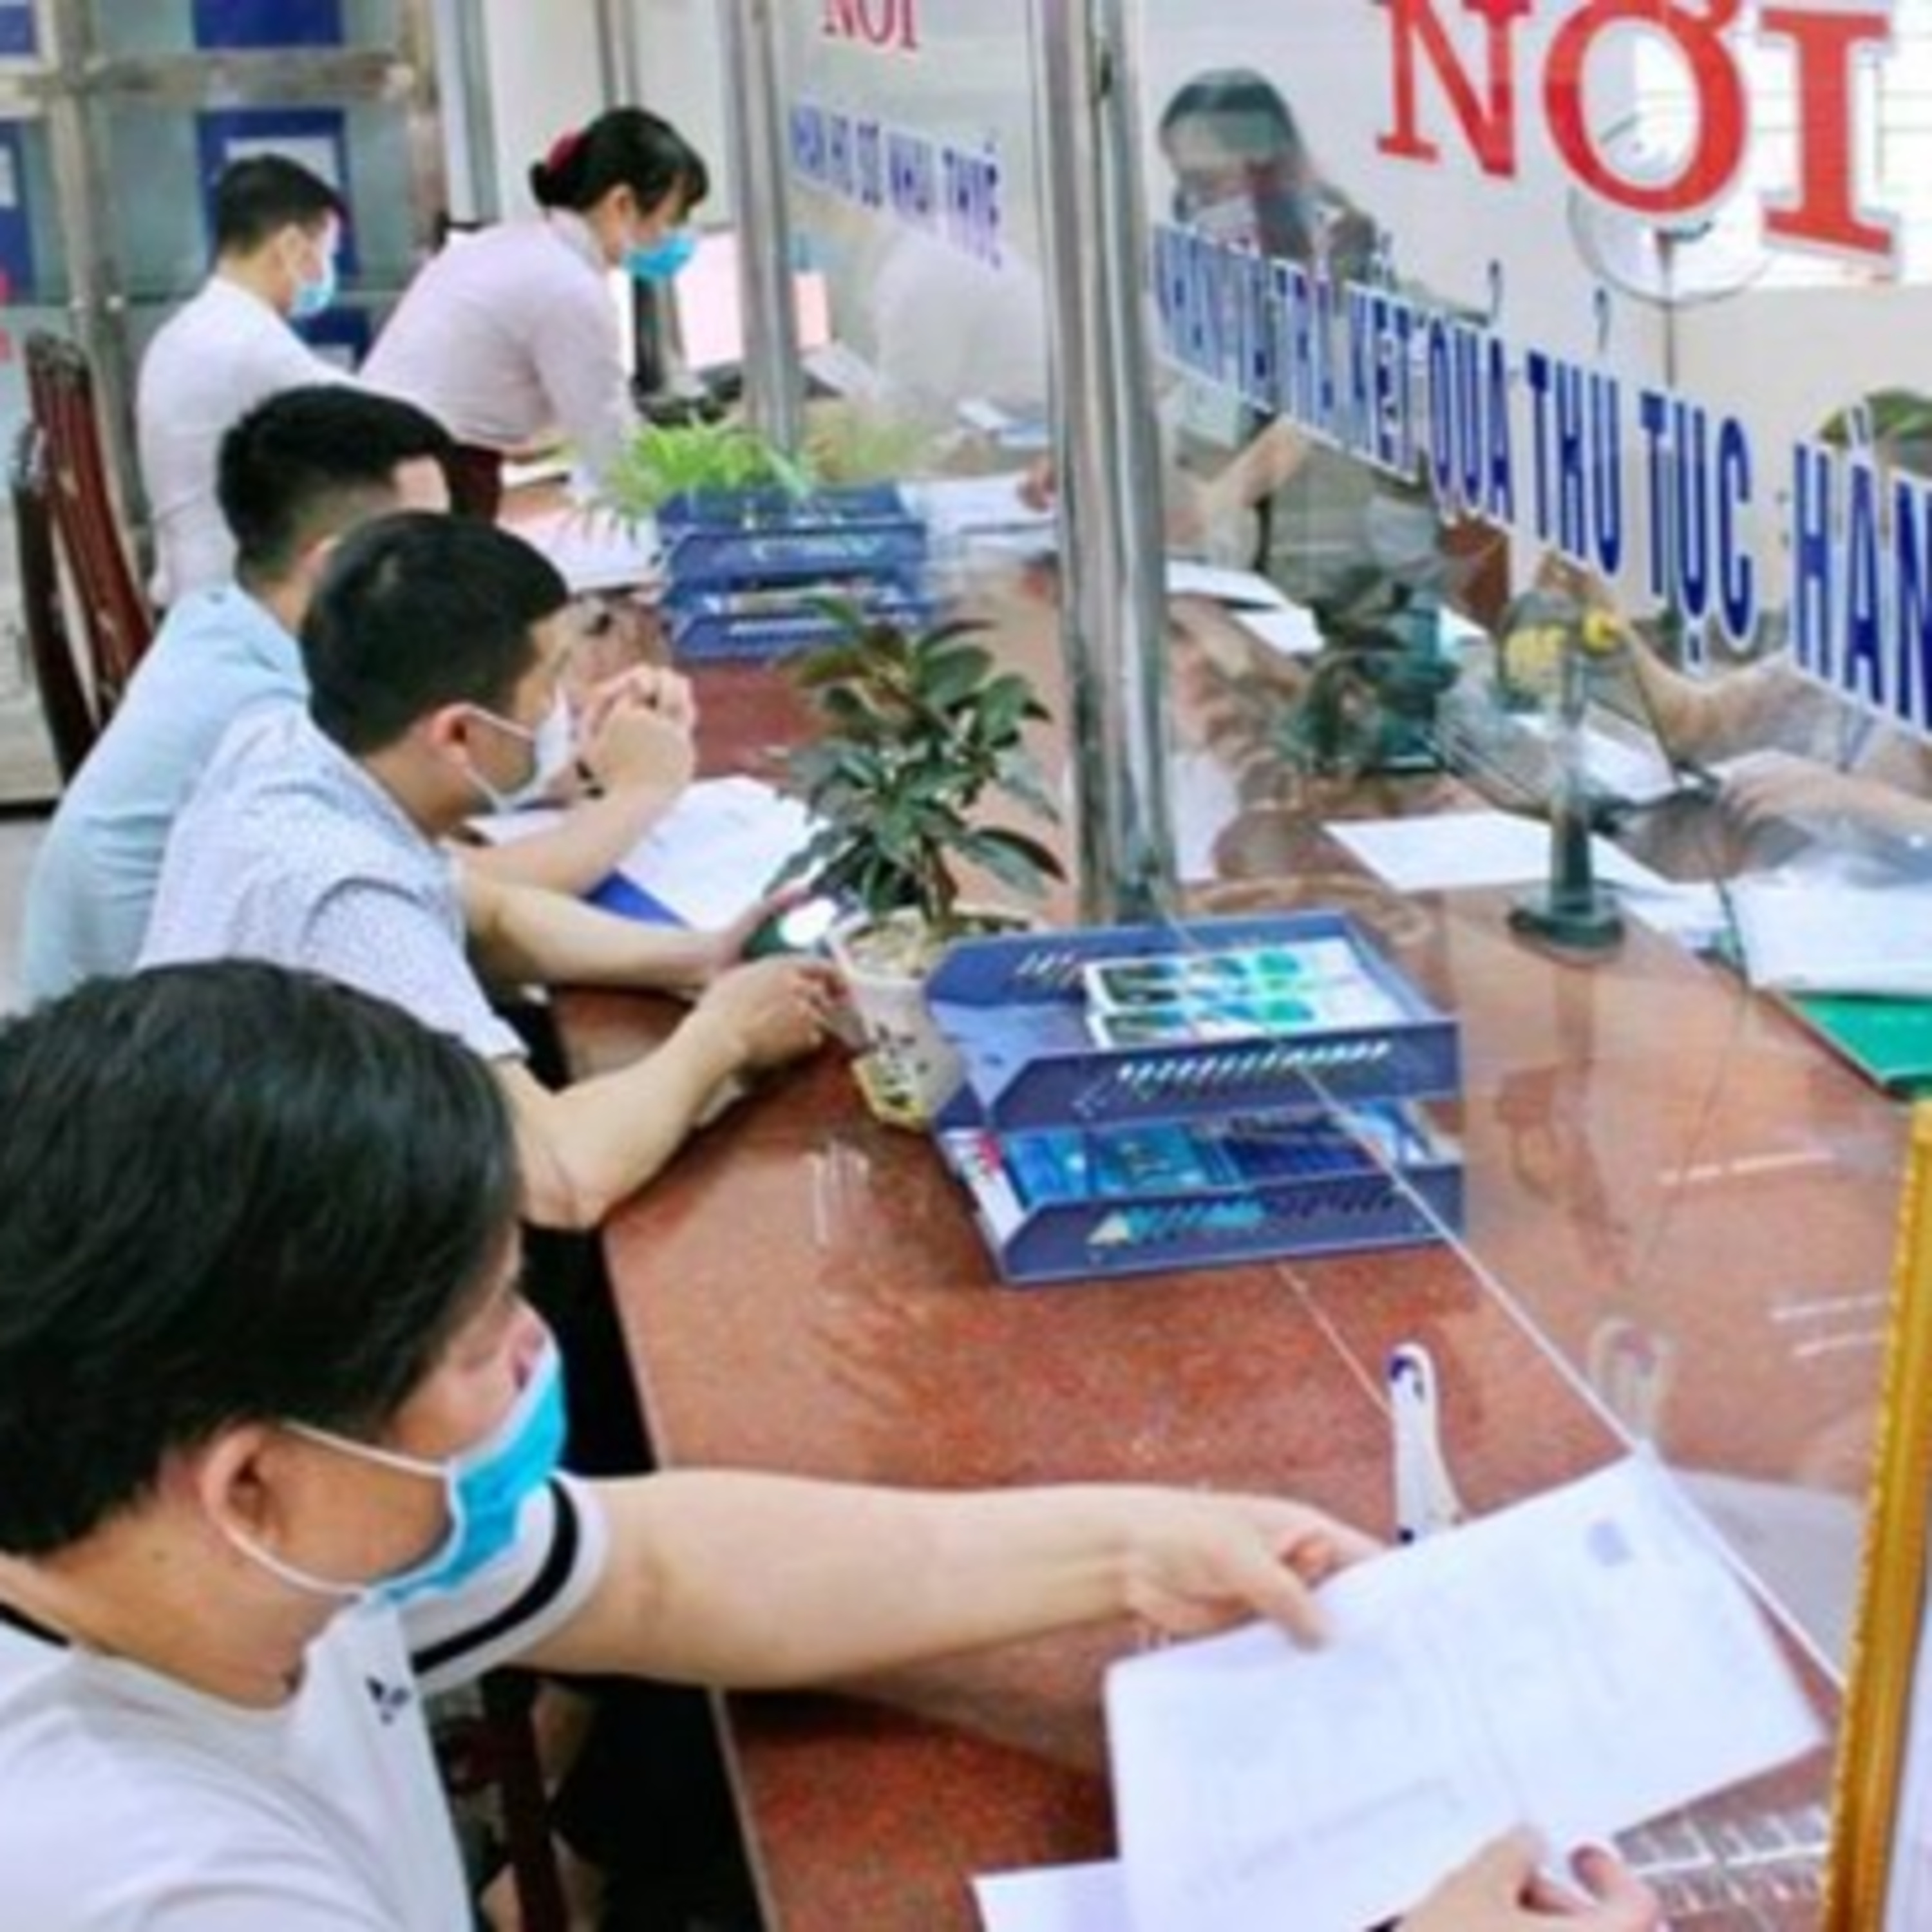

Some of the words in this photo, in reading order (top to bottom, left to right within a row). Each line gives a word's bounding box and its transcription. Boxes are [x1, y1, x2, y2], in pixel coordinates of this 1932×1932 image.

[1375, 0, 1893, 255] NƠI
[1428, 259, 1514, 524] QUẢ
[1528, 290, 1622, 575] THỦ
[1640, 389, 1752, 662] TỤC
